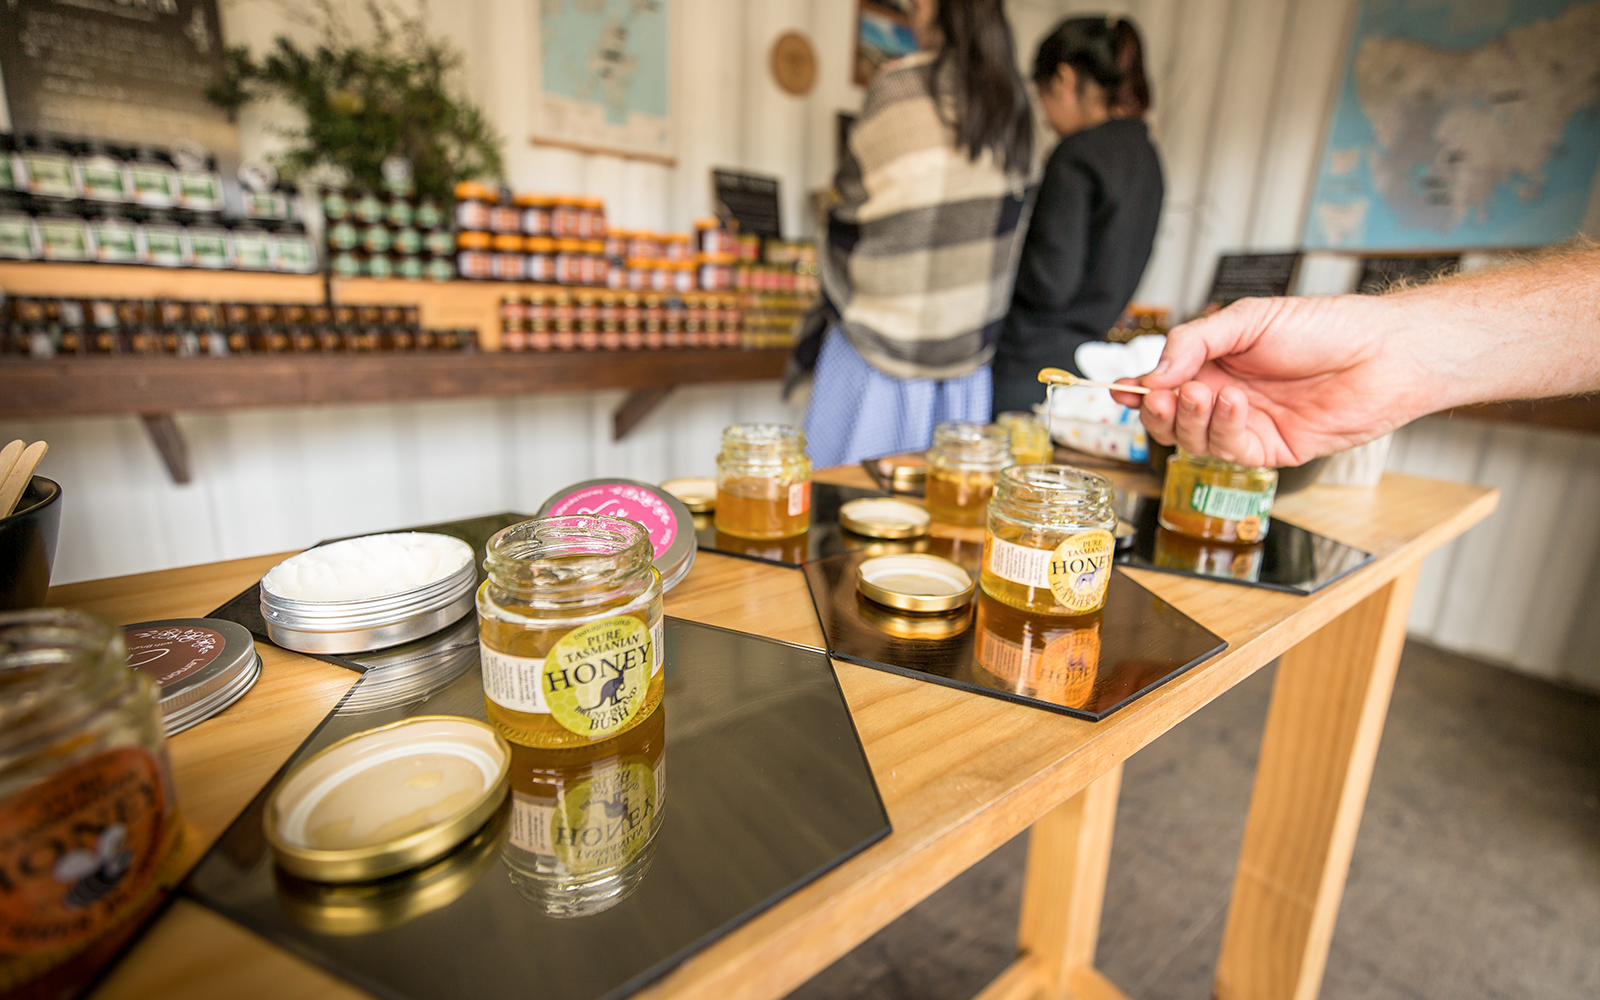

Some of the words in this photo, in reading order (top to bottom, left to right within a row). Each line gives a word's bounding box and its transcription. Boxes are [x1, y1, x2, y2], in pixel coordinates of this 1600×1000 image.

[1083, 540, 1103, 548] PURE
[564, 633, 640, 663] TASMANIAN
[587, 628, 621, 646] PURE
[544, 641, 652, 692] HONEY
[589, 707, 630, 731] BUSH
